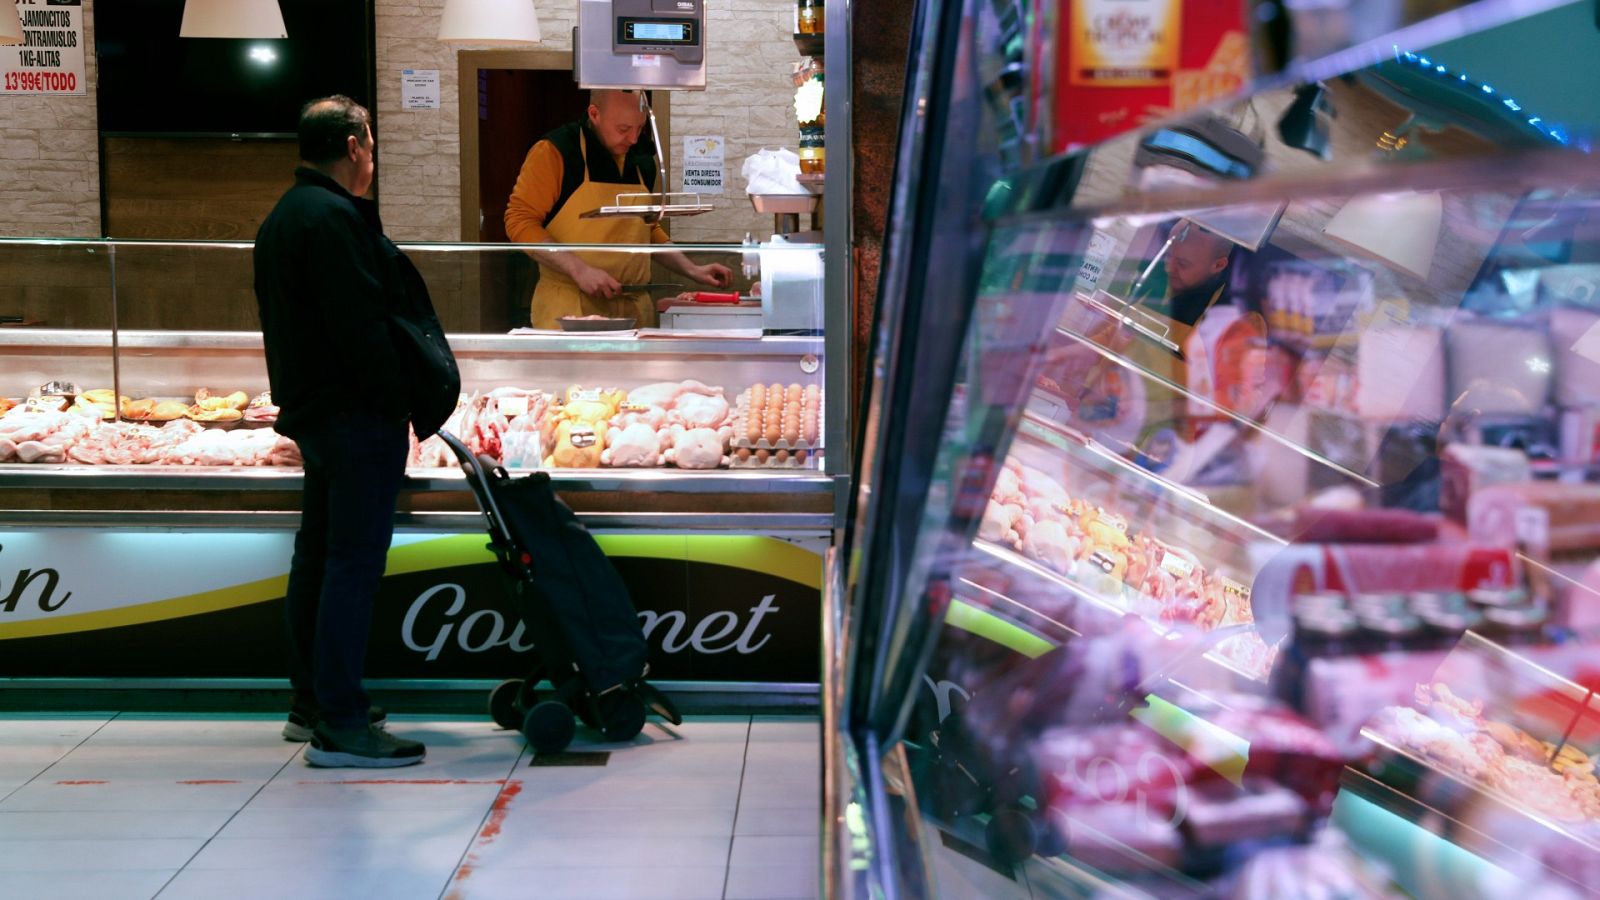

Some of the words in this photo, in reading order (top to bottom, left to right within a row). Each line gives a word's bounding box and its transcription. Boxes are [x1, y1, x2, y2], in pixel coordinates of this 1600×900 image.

[18, 11, 70, 27] -JAMONCITOS
[19, 31, 76, 47] ONTRAMUSLOS
[19, 50, 60, 67] 1KG-ALITAS
[5, 71, 76, 91] 13'99€/TODO
